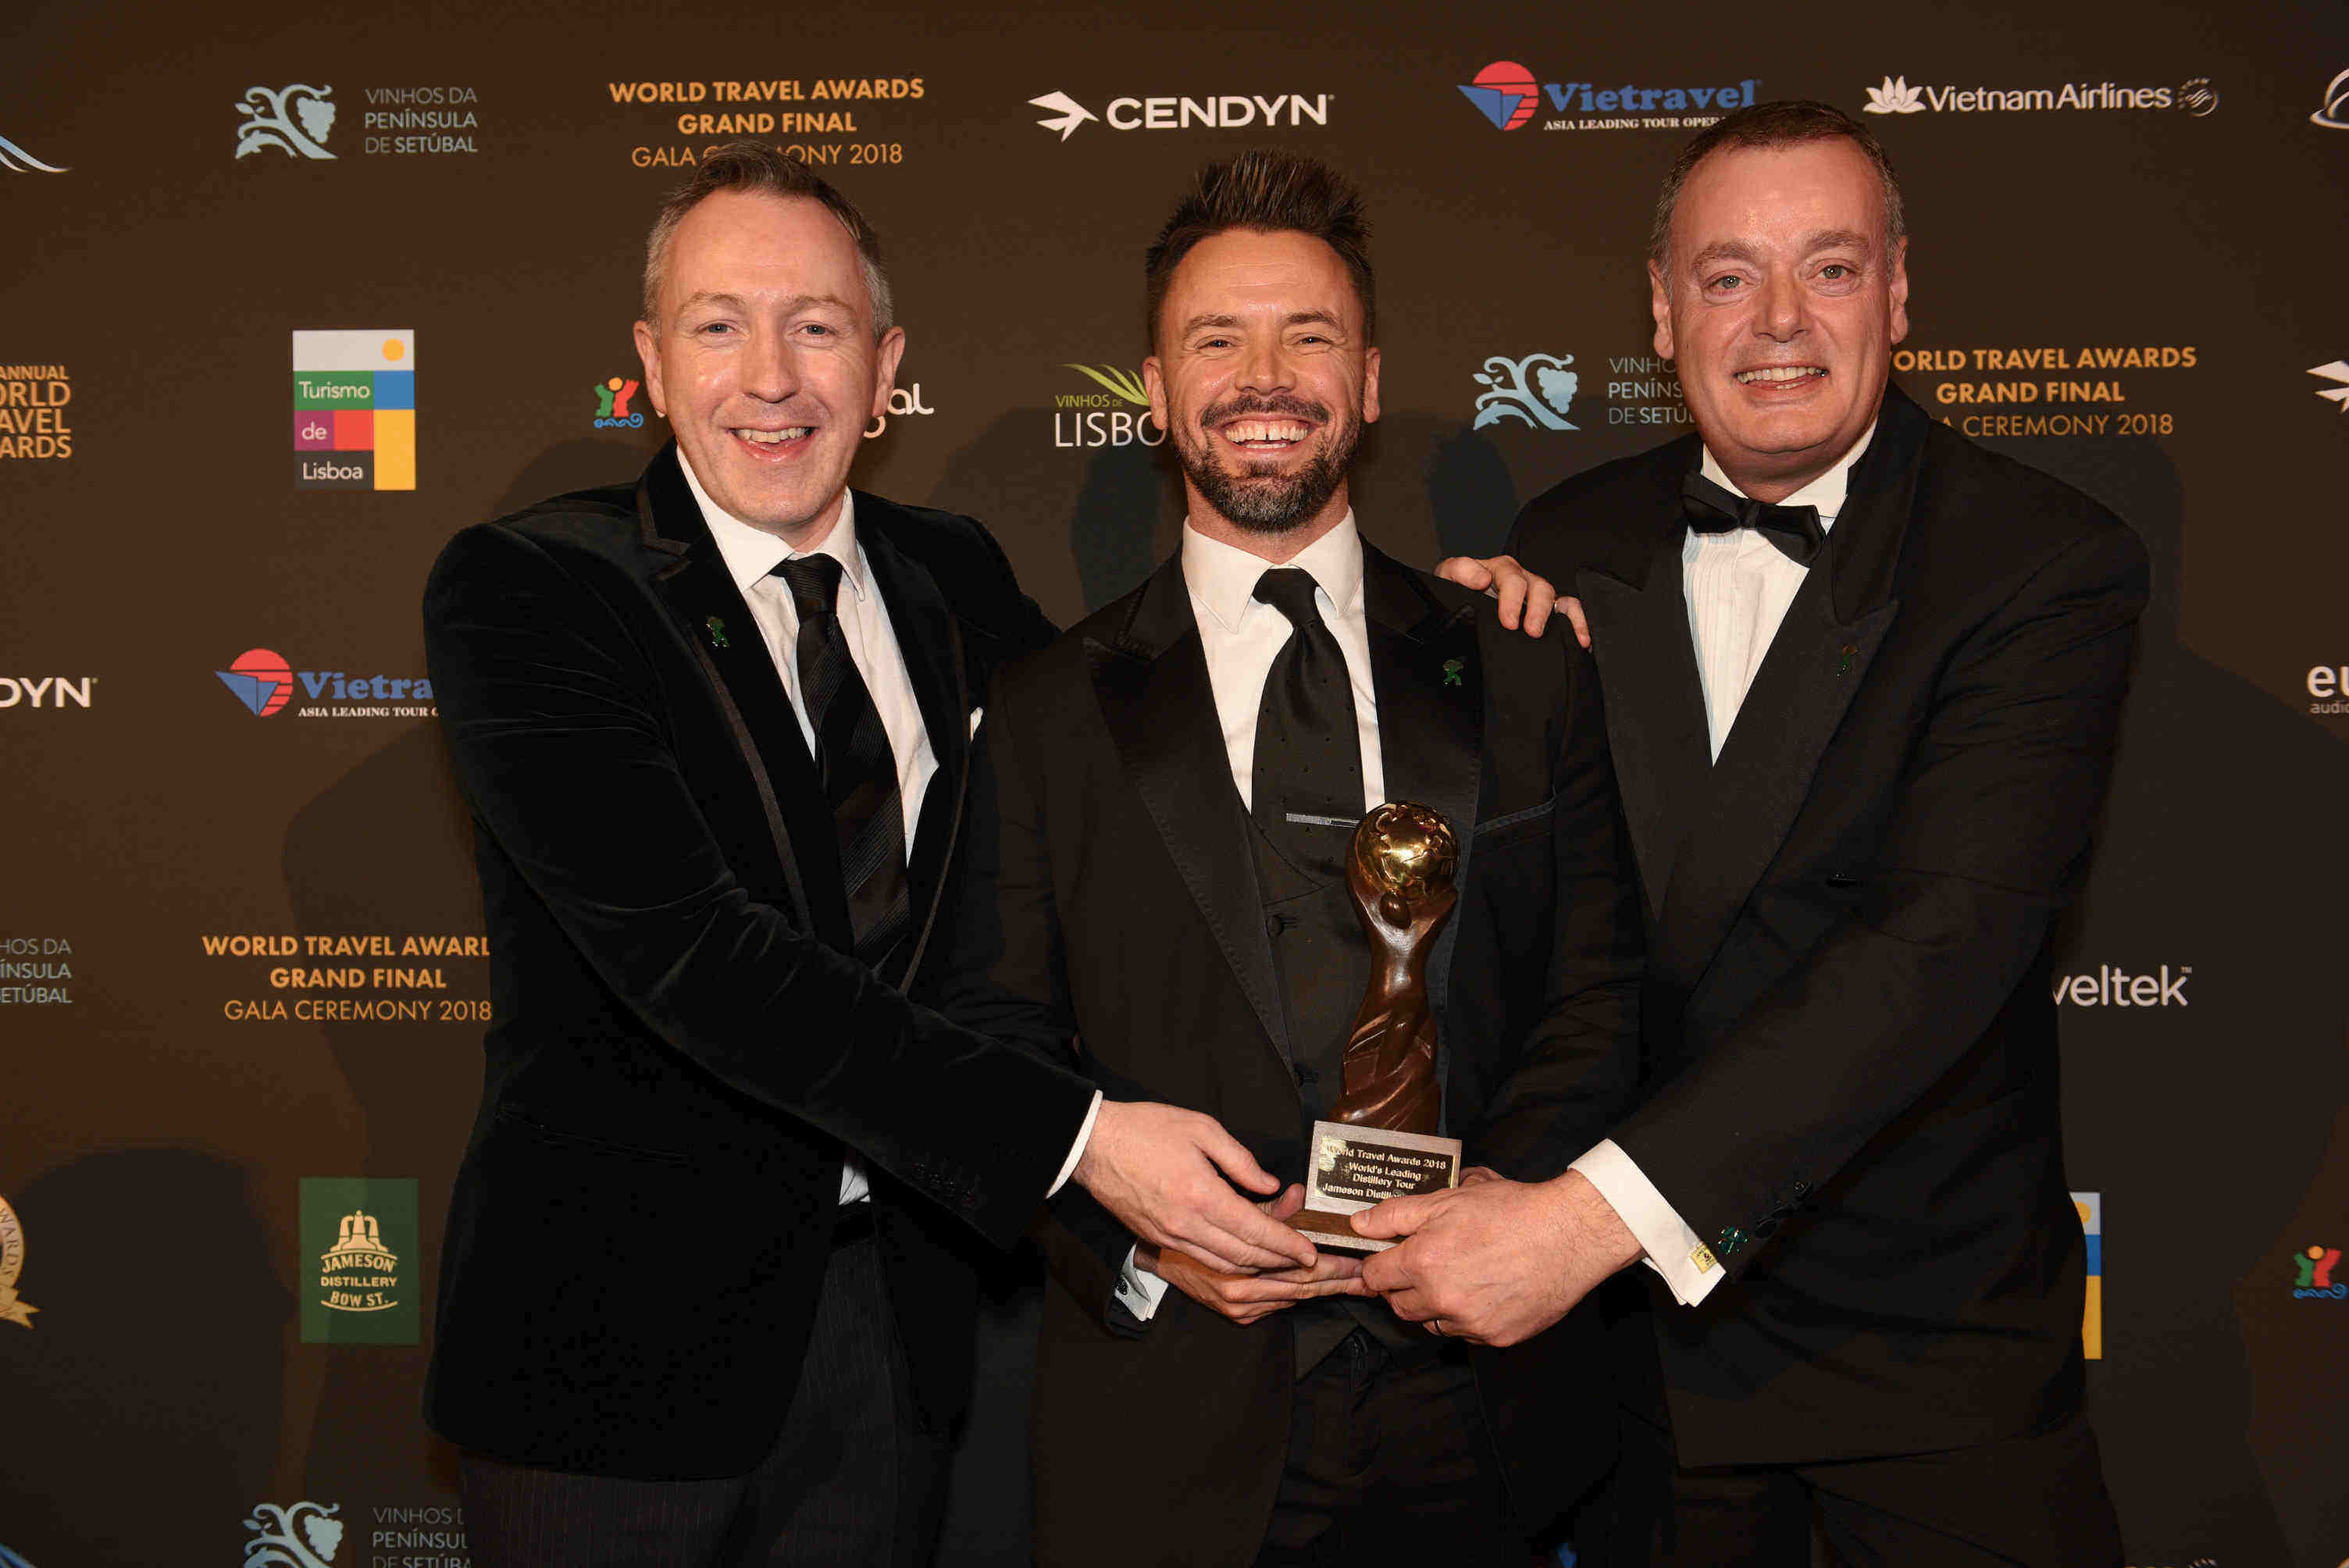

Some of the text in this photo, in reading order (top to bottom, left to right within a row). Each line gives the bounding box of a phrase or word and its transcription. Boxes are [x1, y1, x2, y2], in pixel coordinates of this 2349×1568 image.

[365, 87, 478, 104] VINHOS DA
[609, 78, 925, 102] WORLD TRAVEL AWARDS
[1544, 79, 1757, 112] Vietravel
[1926, 82, 2172, 112] Vietnam Airlines
[365, 108, 478, 128] PENÍNSULA
[1107, 94, 1328, 130] CENDYN
[678, 112, 857, 134] GRAND FINAL
[1543, 119, 1575, 130] ASIA
[1579, 118, 1639, 130] LEADING
[1642, 117, 1679, 128] TOUR
[365, 132, 479, 154] DE SETÚBAL
[631, 146, 697, 167] GALA
[850, 144, 903, 165] 2018
[1973, 348, 2070, 370] TRAVEL
[2076, 347, 2198, 368] AWARDS
[298, 380, 370, 399] Turismo
[1937, 381, 2125, 404] GRAND FINAL
[1055, 394, 1123, 408] VINHOS DE
[1609, 407, 1636, 424] DE
[1962, 415, 2110, 437] CEREMONY
[2117, 413, 2174, 435] 2018
[301, 420, 327, 440] de
[0, 435, 73, 458] ARDS
[303, 461, 364, 480] Lisboa
[298, 707, 329, 718] ASIA
[332, 707, 390, 718] LEADING
[393, 707, 428, 717] TOUR
[44, 939, 73, 954] DA
[201, 935, 298, 957] WORLD
[305, 936, 395, 957] TRAVEL
[270, 968, 447, 989] GRAND FINAL
[224, 1000, 492, 1021] GALA CEREMONY 2018
[1327, 1145, 1446, 1170] World Travel Awards 2018
[1349, 1161, 1421, 1181] World's Leading
[1353, 1173, 1416, 1189] Distillery Tour
[1322, 1182, 1363, 1196] Jameson
[322, 1253, 395, 1274] JAMESON
[320, 1276, 397, 1288] DISTILLERY
[330, 1290, 389, 1307] BOW ST.
[372, 1506, 453, 1524] VINHOS
